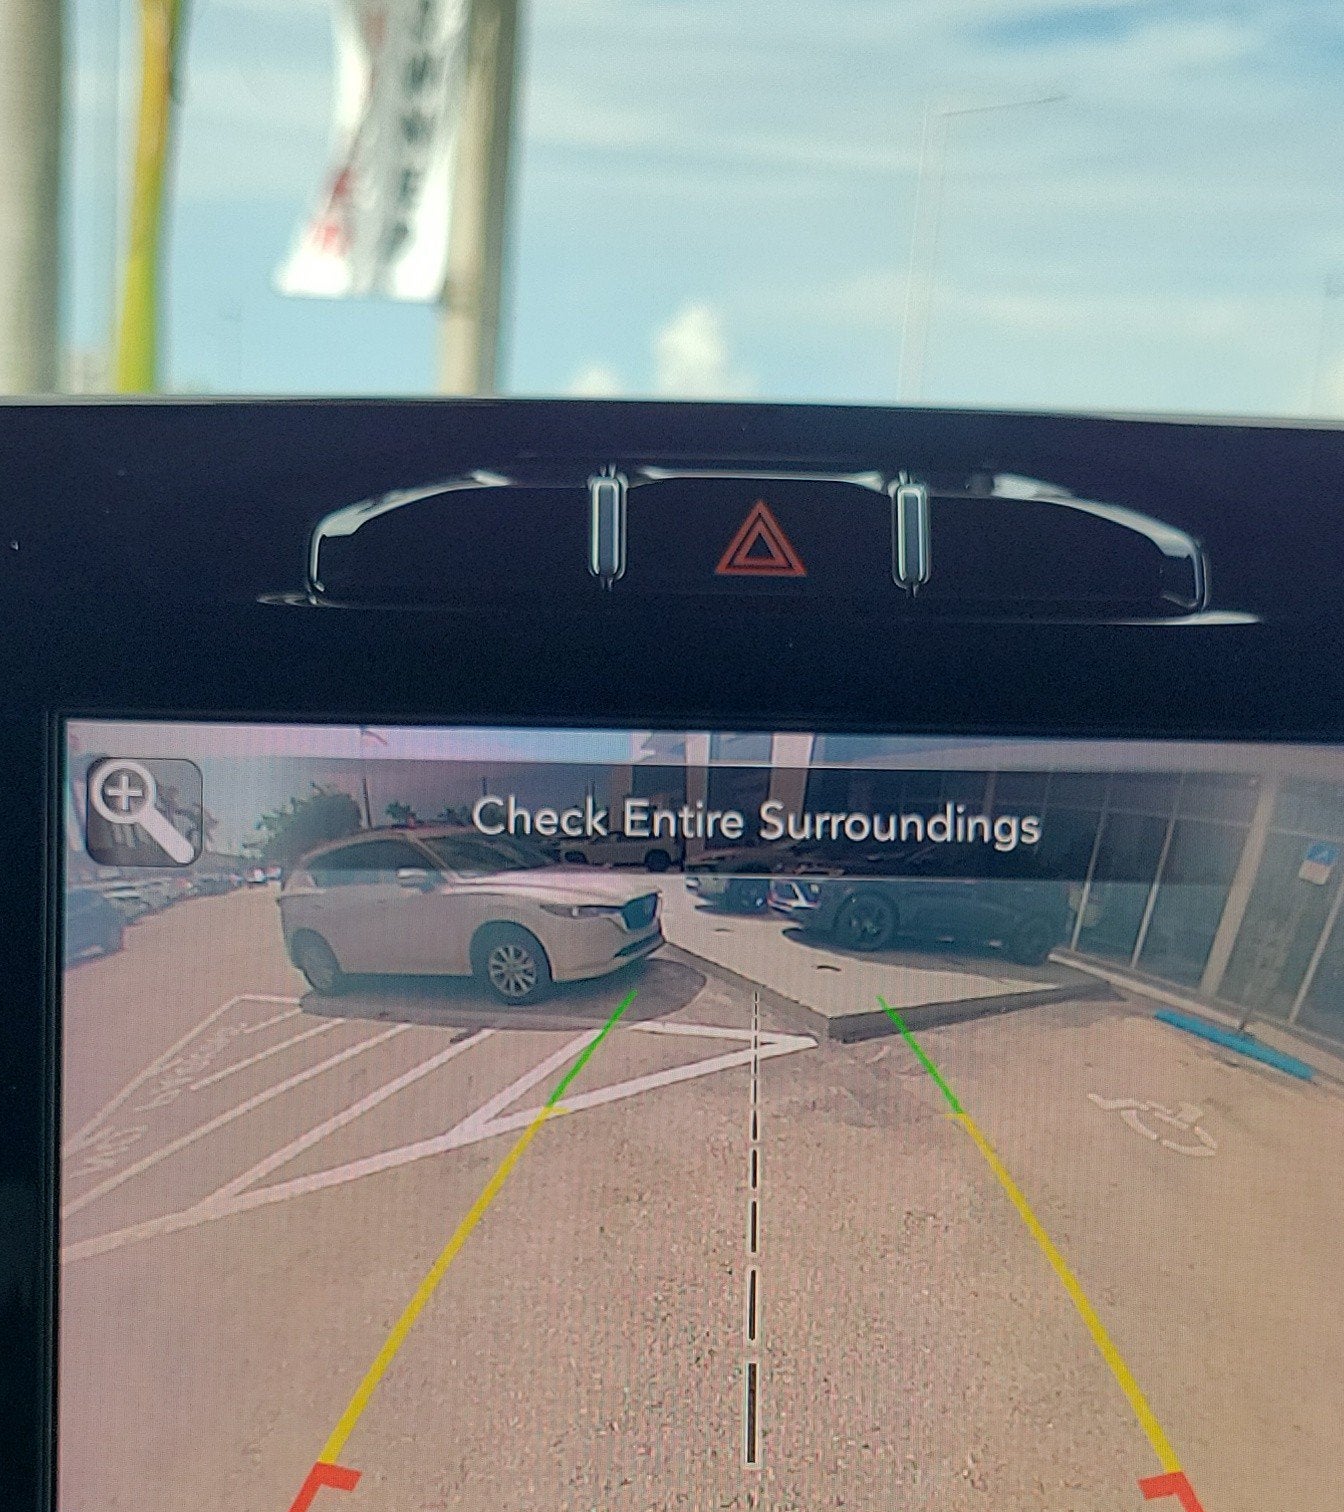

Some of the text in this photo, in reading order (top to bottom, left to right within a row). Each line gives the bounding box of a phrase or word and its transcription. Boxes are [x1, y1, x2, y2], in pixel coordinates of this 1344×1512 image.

[471, 795, 1042, 852] Check Entire Surroundings
